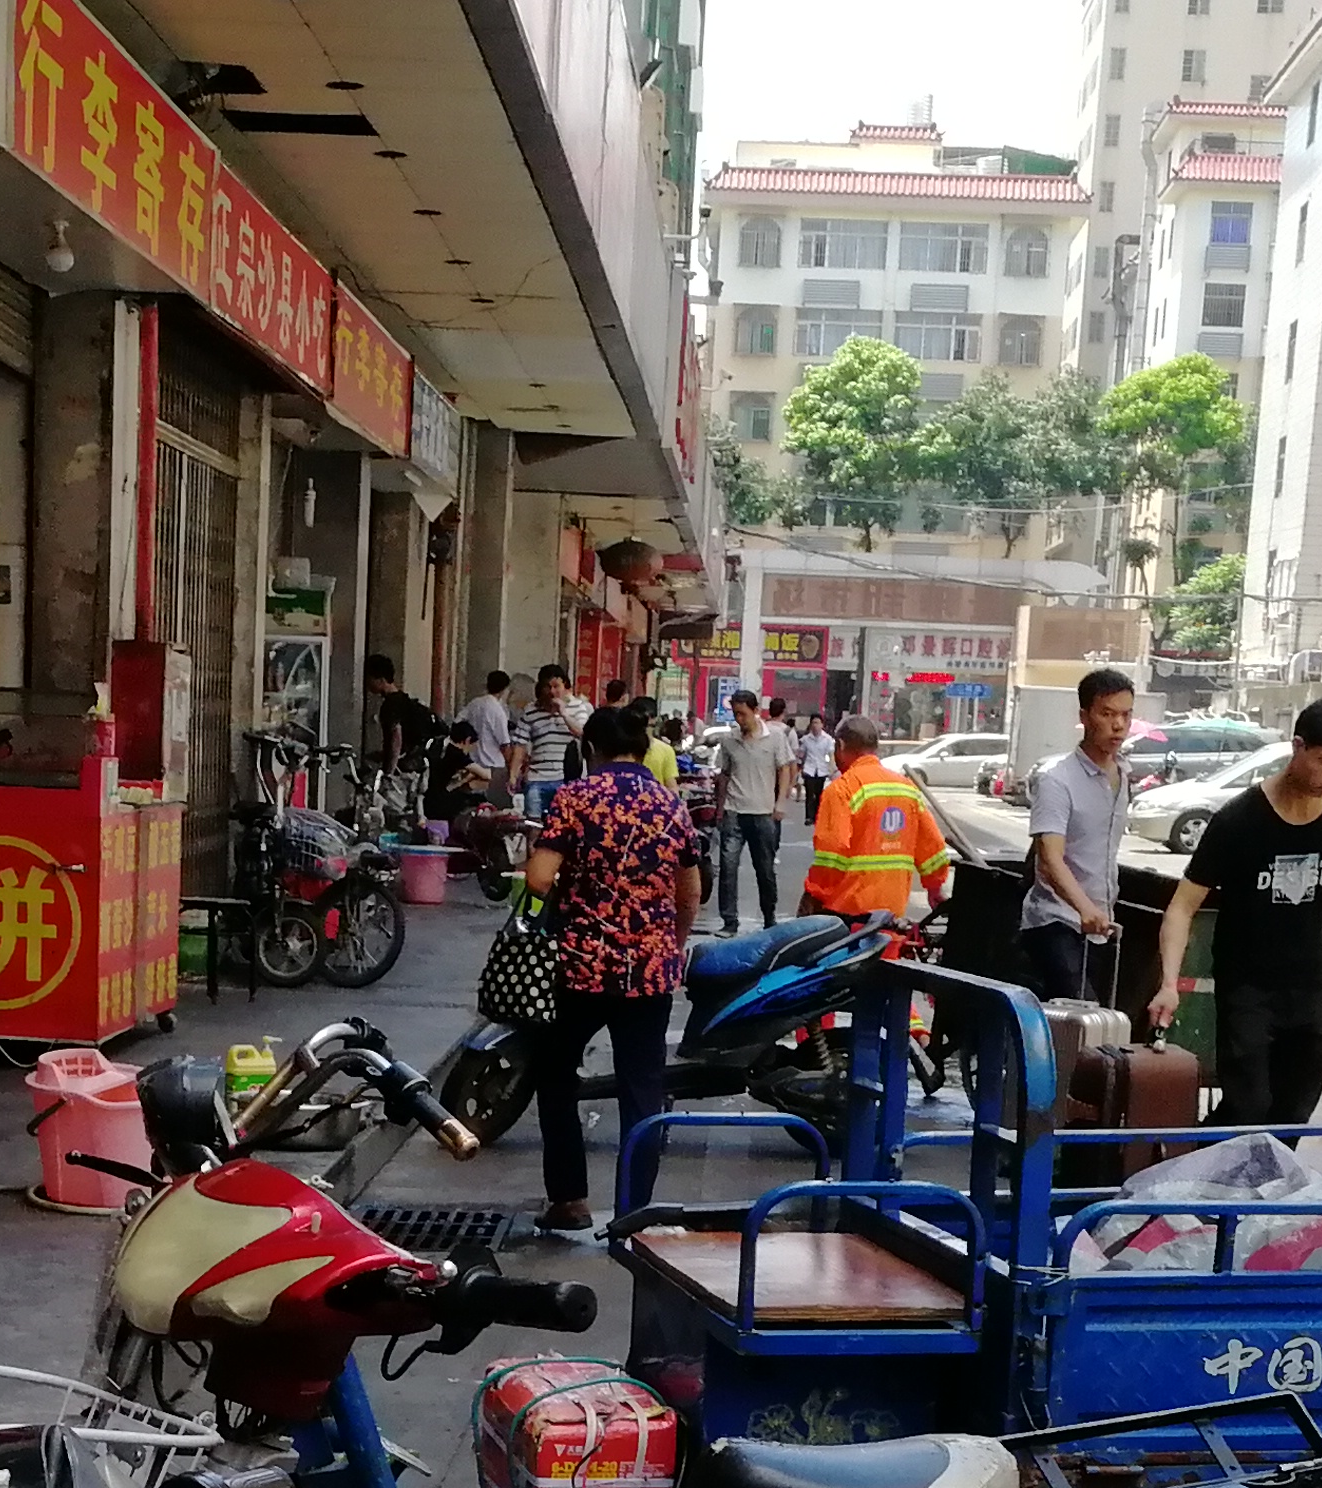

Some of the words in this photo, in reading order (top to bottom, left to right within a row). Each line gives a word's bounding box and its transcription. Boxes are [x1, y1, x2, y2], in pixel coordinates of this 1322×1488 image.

[19, 0, 205, 287] 行李寄存
[210, 188, 327, 379] 正宗沙县小吃
[336, 306, 404, 422] 行李寄存
